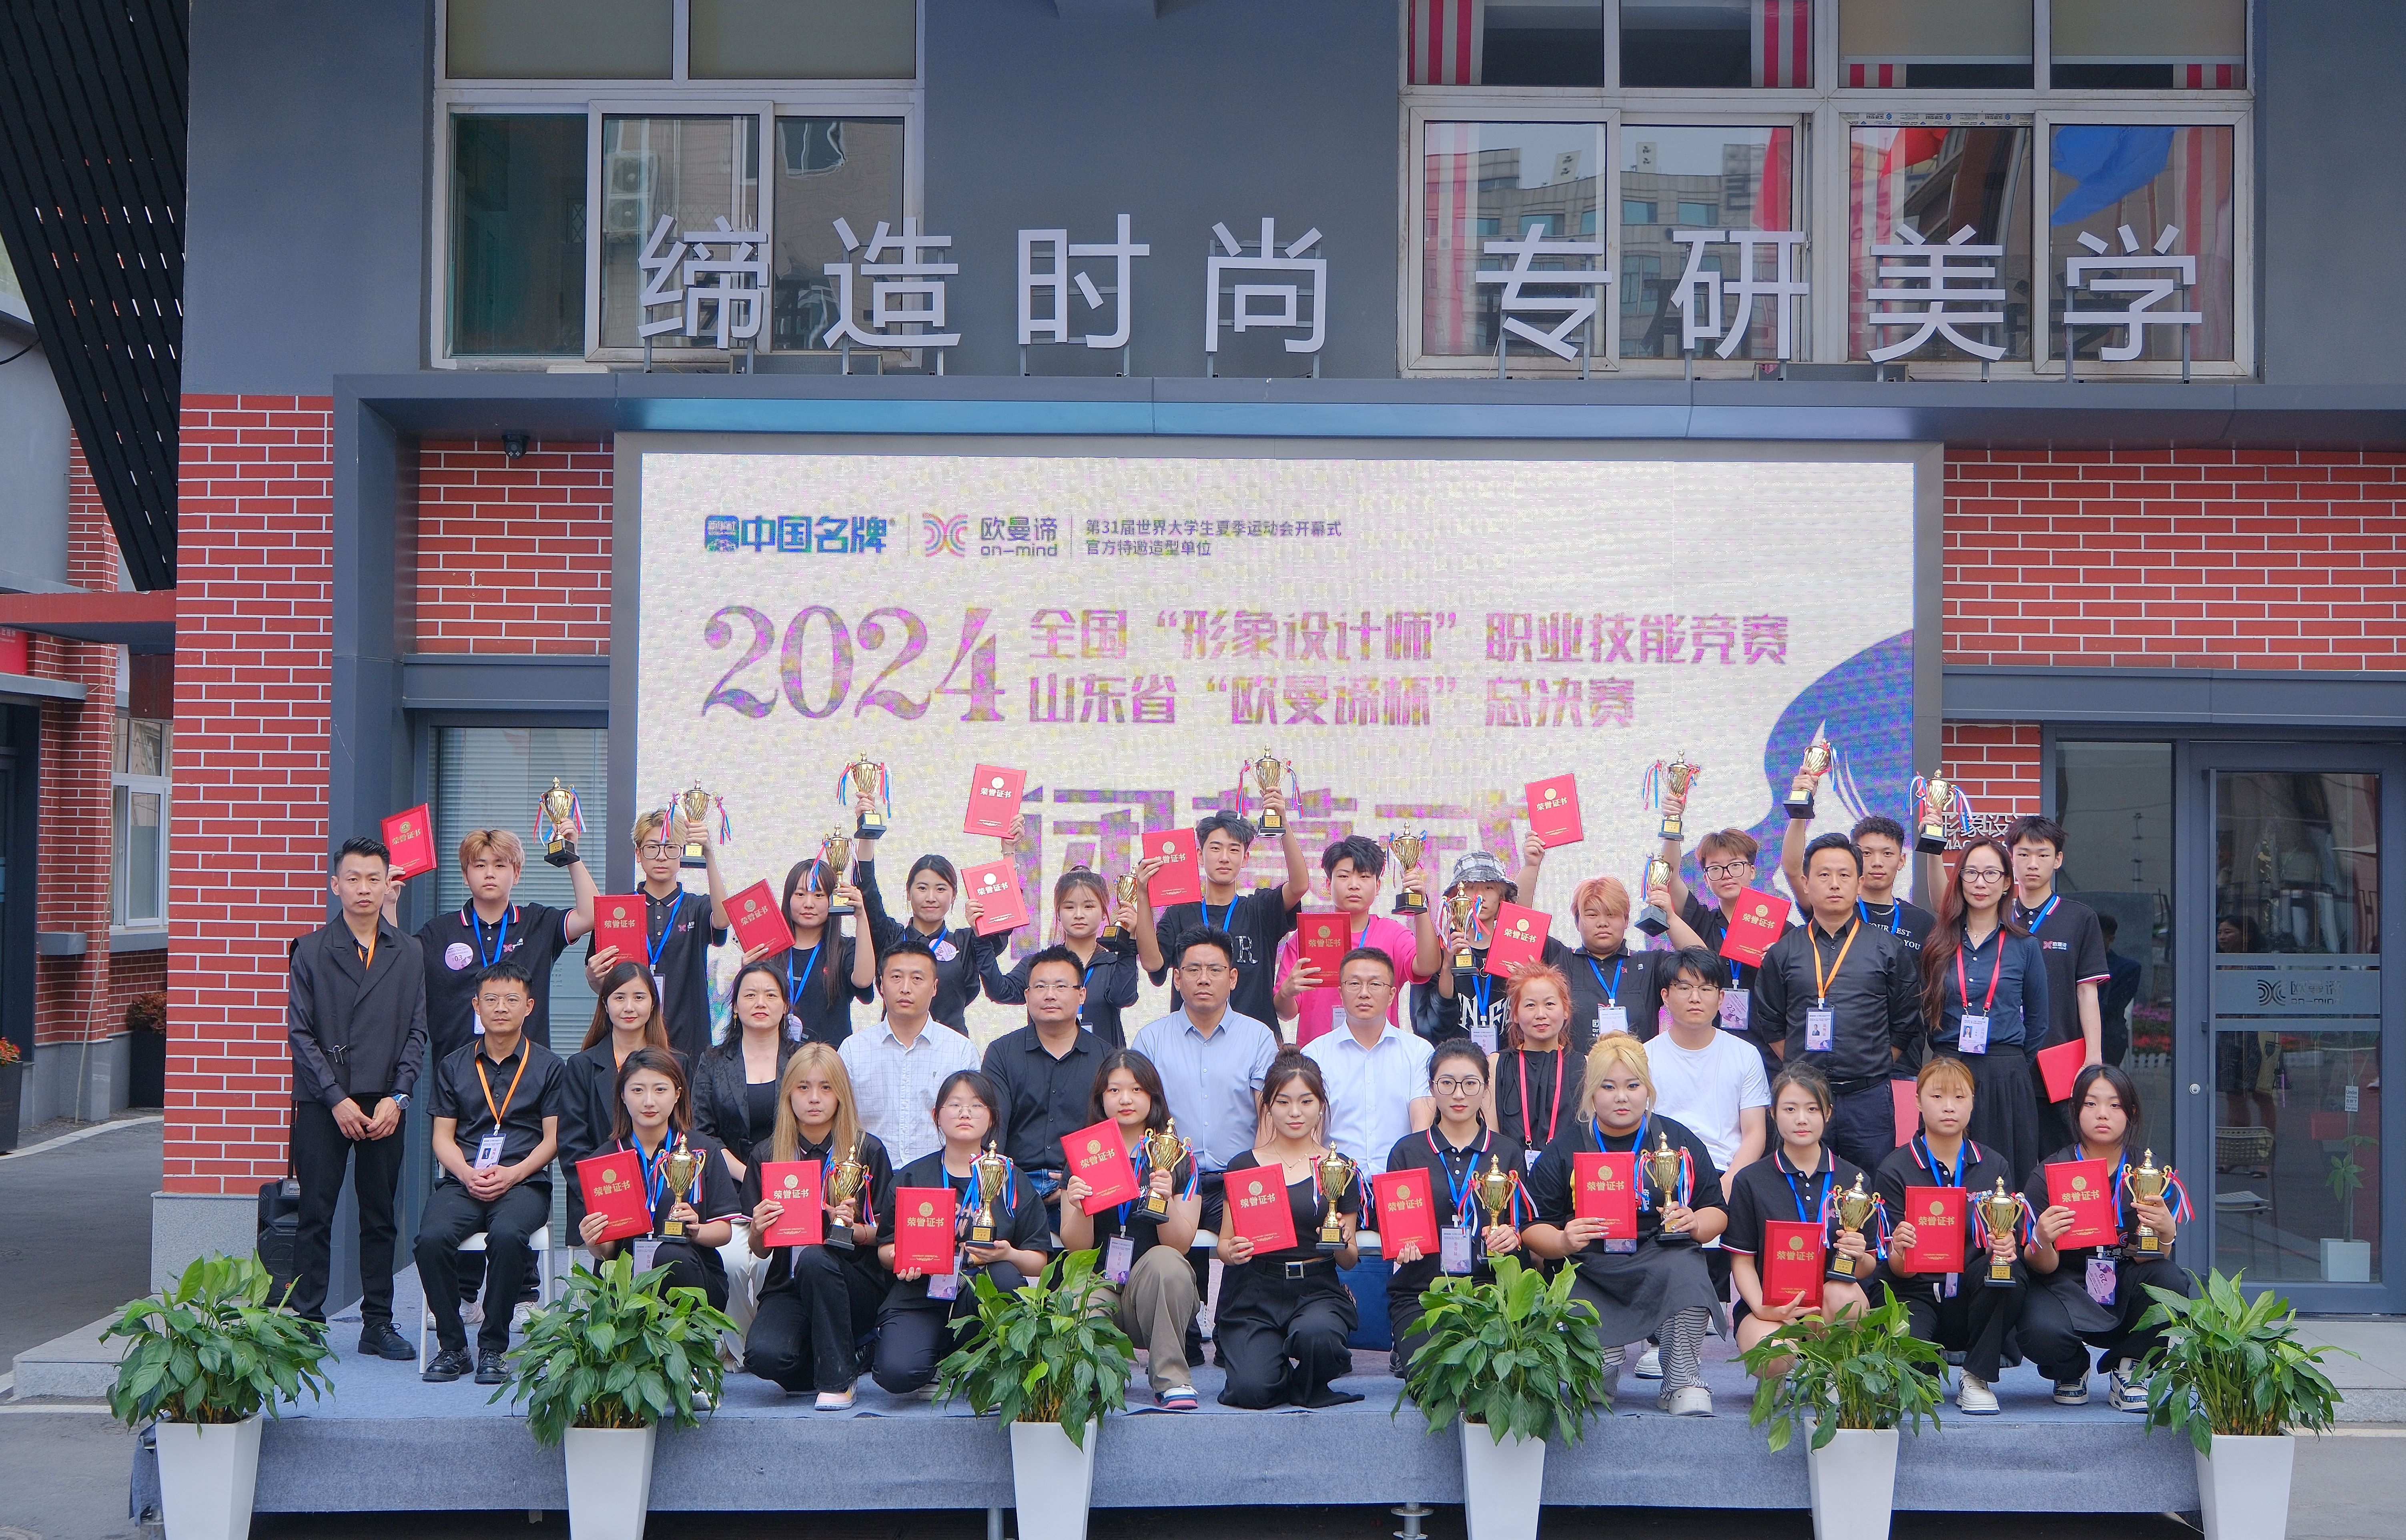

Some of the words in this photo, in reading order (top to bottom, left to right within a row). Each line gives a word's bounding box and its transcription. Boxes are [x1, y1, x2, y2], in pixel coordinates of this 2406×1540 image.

[638, 214, 1328, 353] 缔造时尚
[1475, 223, 2202, 363] 专研美学
[742, 515, 887, 553] 中国名牌
[980, 516, 1058, 543] 欧曼谛
[1085, 539, 1211, 556] 官方特邀造型单位
[700, 605, 1006, 722] 2024
[980, 787, 1012, 798] 荣誉证书
[1536, 797, 1568, 811] 荣誉证书
[977, 882, 1009, 896] 荣誉证书
[740, 906, 768, 926] 荣誉证书
[1742, 912, 1776, 929] 荣誉证书
[604, 920, 636, 928] 荣誉证书
[1504, 928, 1537, 943] 荣誉证书
[1891, 926, 1911, 937] EST
[1308, 938, 1341, 947] 荣誉证书
[1903, 939, 1921, 950] YOU
[1235, 935, 1258, 965] R
[1726, 1004, 1735, 1013] 23
[1080, 1148, 1116, 1169] 荣誉证书
[593, 1180, 631, 1197] 荣誉证书
[1586, 1181, 1625, 1191] 荣誉证书
[773, 1189, 809, 1199] 荣誉证书
[1240, 1193, 1276, 1209] 荣誉证书
[2061, 1189, 2099, 1203] 荣誉证书
[1387, 1197, 1423, 1212] 荣誉证书
[907, 1217, 944, 1227] 荣誉证书
[1918, 1216, 1955, 1226] 荣誉证书
[1777, 1251, 1815, 1261] 荣誉证书
[2099, 1273, 2107, 1283] 29
